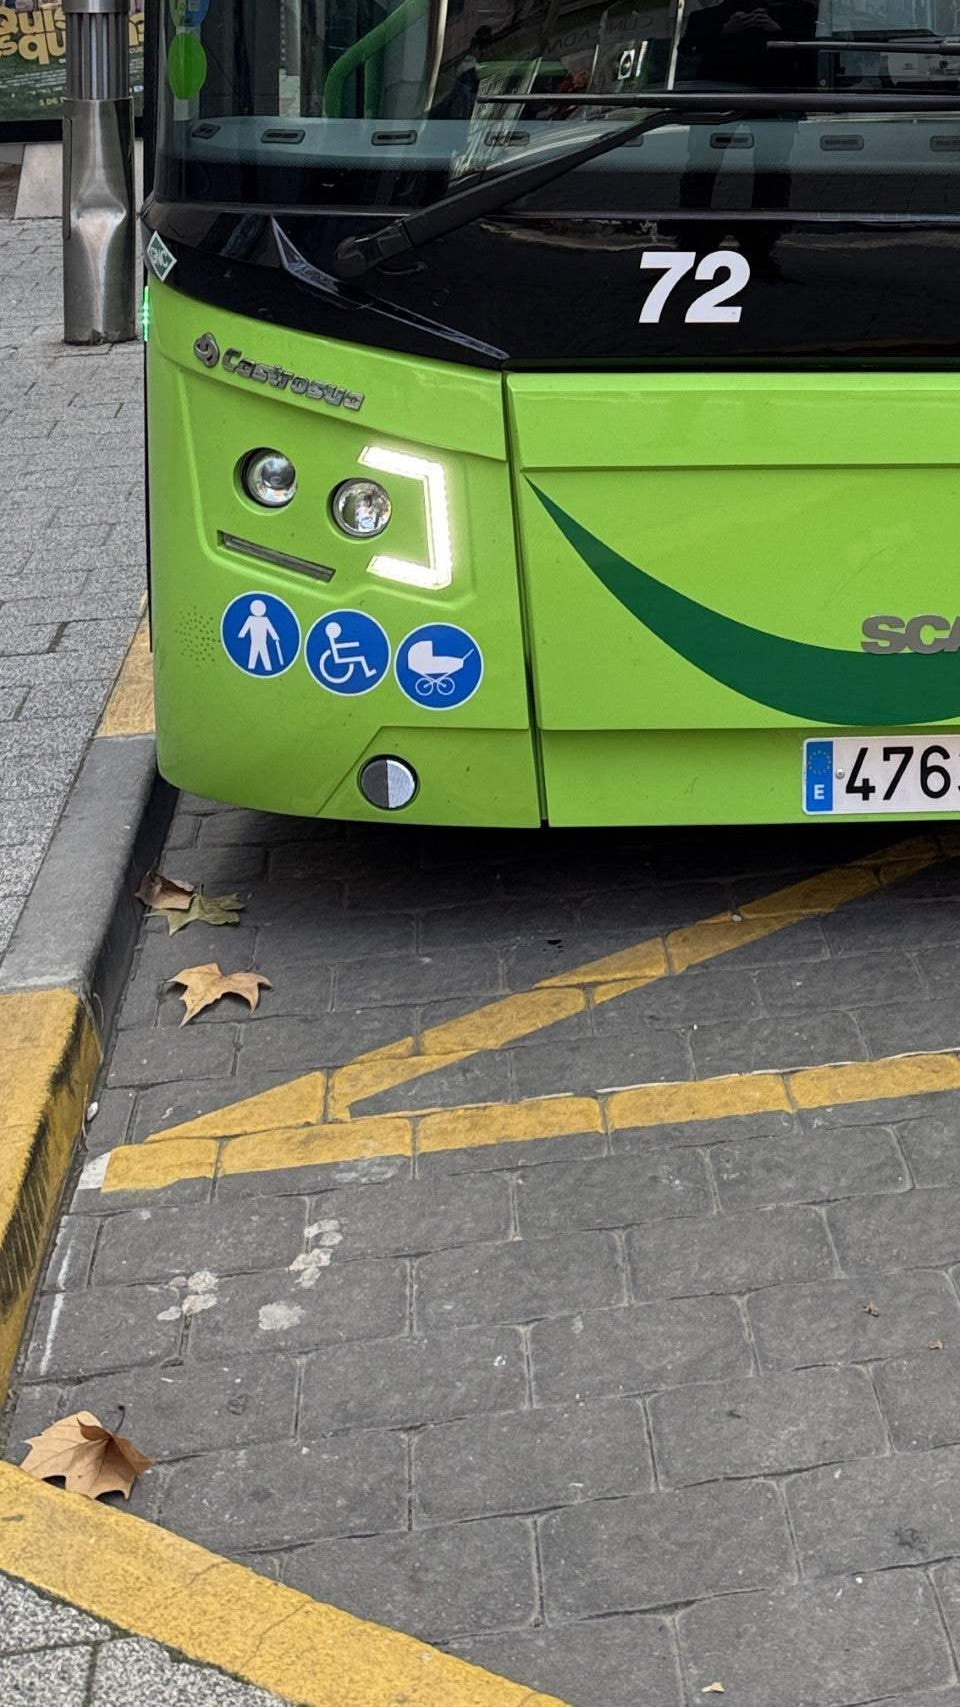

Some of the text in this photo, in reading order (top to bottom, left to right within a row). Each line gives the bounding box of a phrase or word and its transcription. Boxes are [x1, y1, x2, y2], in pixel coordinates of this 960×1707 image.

[638, 250, 750, 323] 72
[221, 347, 366, 412] Castrosua
[814, 783, 825, 800] E
